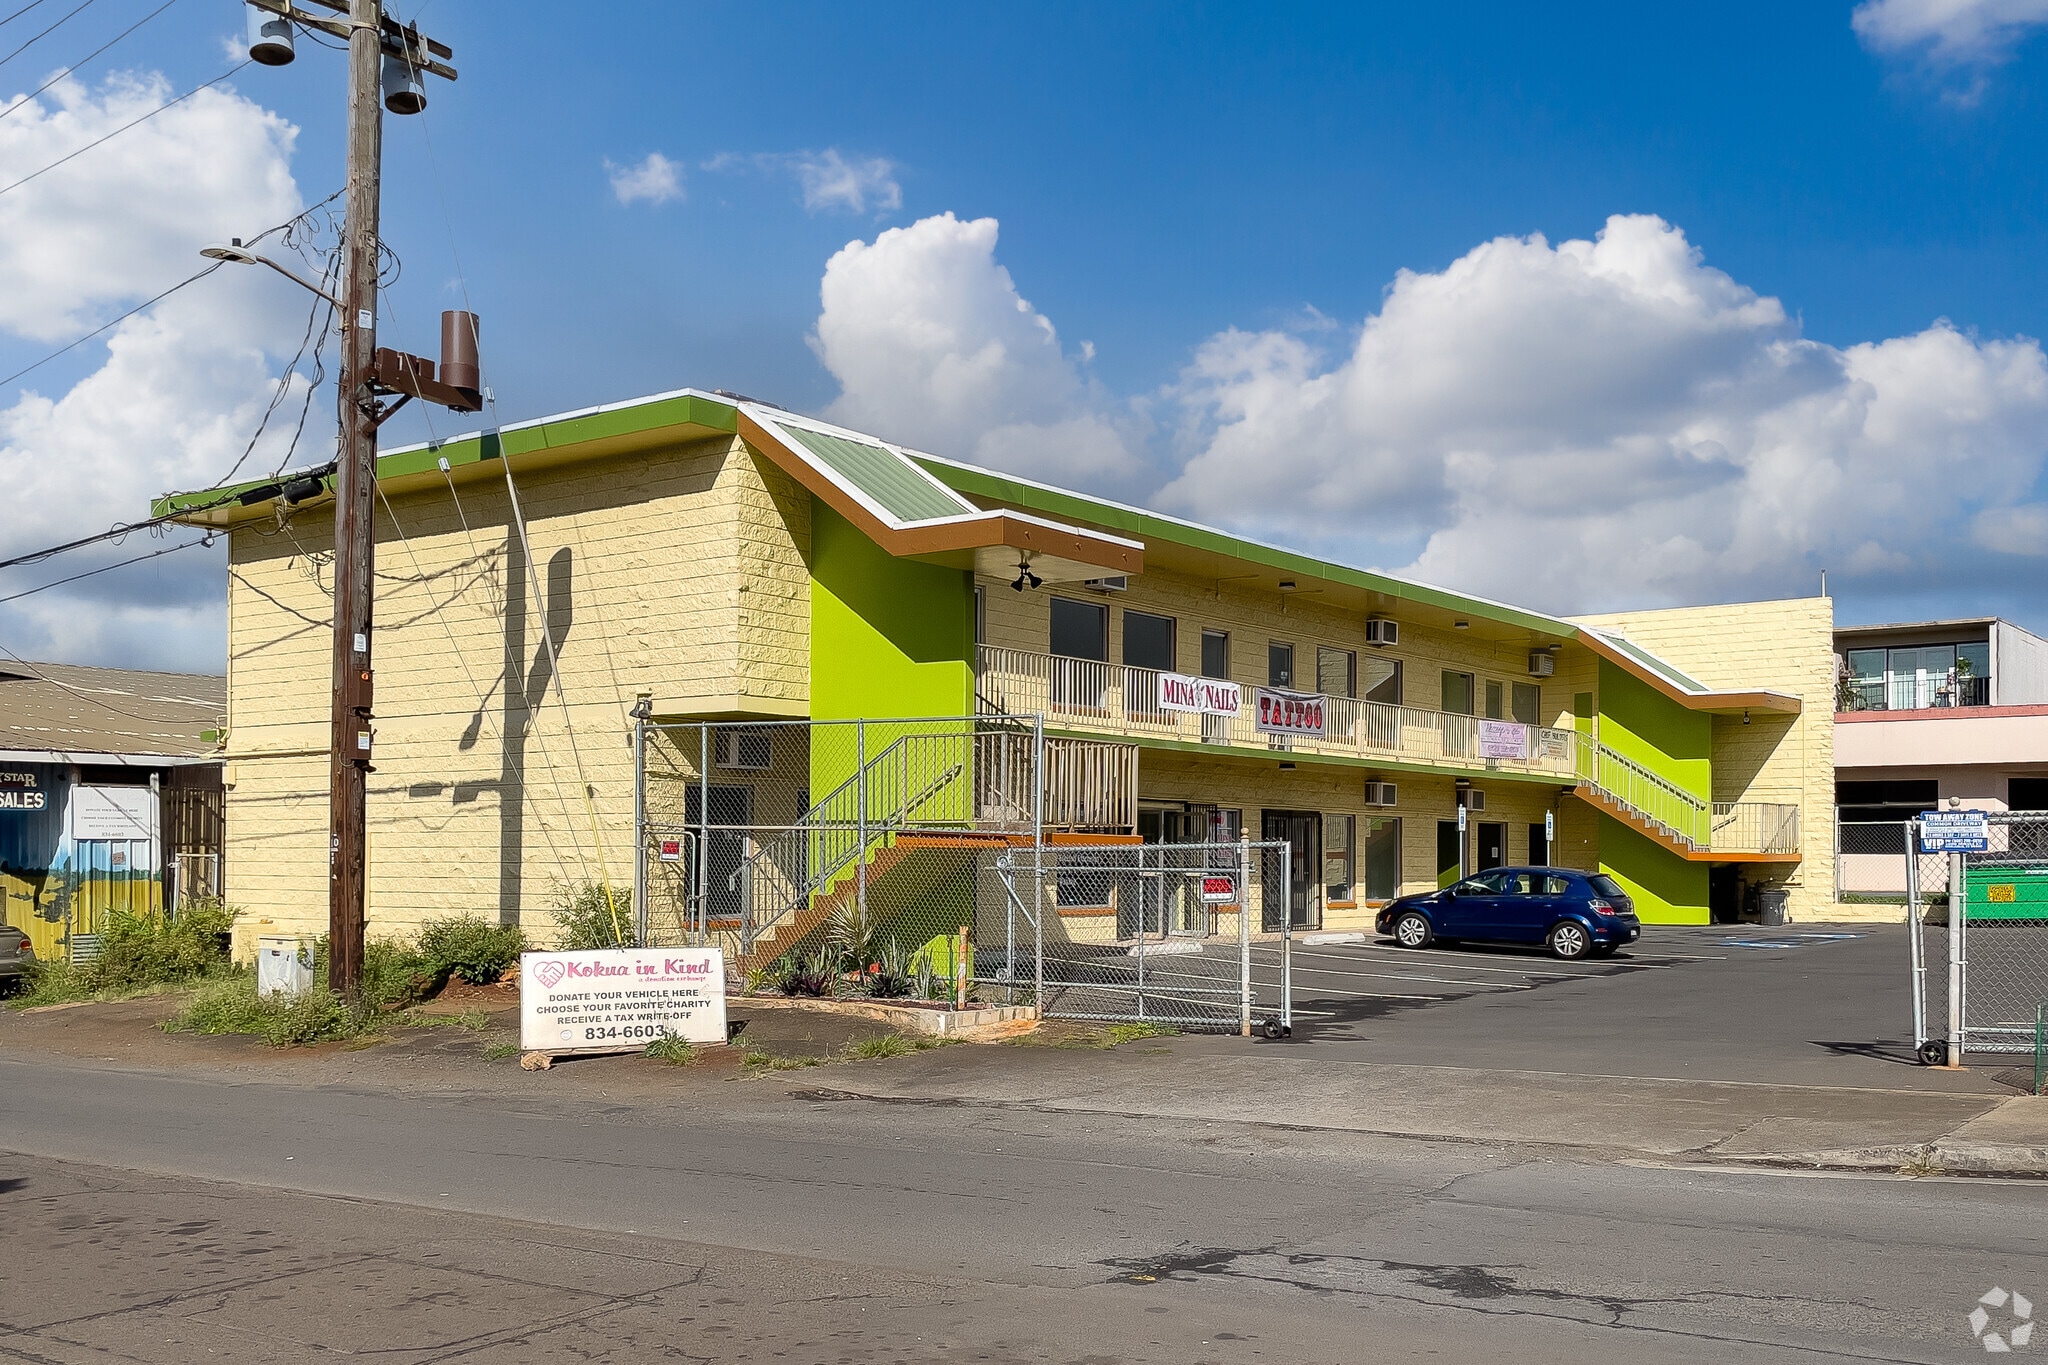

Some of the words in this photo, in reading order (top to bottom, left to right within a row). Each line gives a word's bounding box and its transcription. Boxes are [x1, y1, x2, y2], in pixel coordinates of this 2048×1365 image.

[1163, 678, 1195, 707] MINA
[1205, 684, 1238, 712] NAILS
[1260, 697, 1323, 730] TATTOO
[1924, 813, 1941, 821] TOW
[1942, 813, 1964, 821] AWAY
[1965, 813, 1984, 821] ZONE
[1923, 838, 1945, 850] VIP
[567, 961, 631, 978] Kokua
[635, 959, 658, 975] in
[664, 958, 714, 975] Kind
[549, 992, 591, 1002] DONATE
[593, 991, 622, 1000] YOUR
[625, 989, 669, 999] VEHICLE
[671, 988, 699, 997] HERE
[536, 1004, 580, 1014] CHOOSE
[582, 1002, 612, 1012] YOUR
[614, 1001, 664, 1011] FAVORITE
[666, 999, 711, 1009] CHARITY
[557, 1015, 602, 1024] RECEIVE
[604, 1014, 612, 1022] A
[613, 1013, 634, 1022] TAX
[636, 1011, 692, 1021] WRITE-OFF
[585, 1024, 665, 1040] 834-6603
